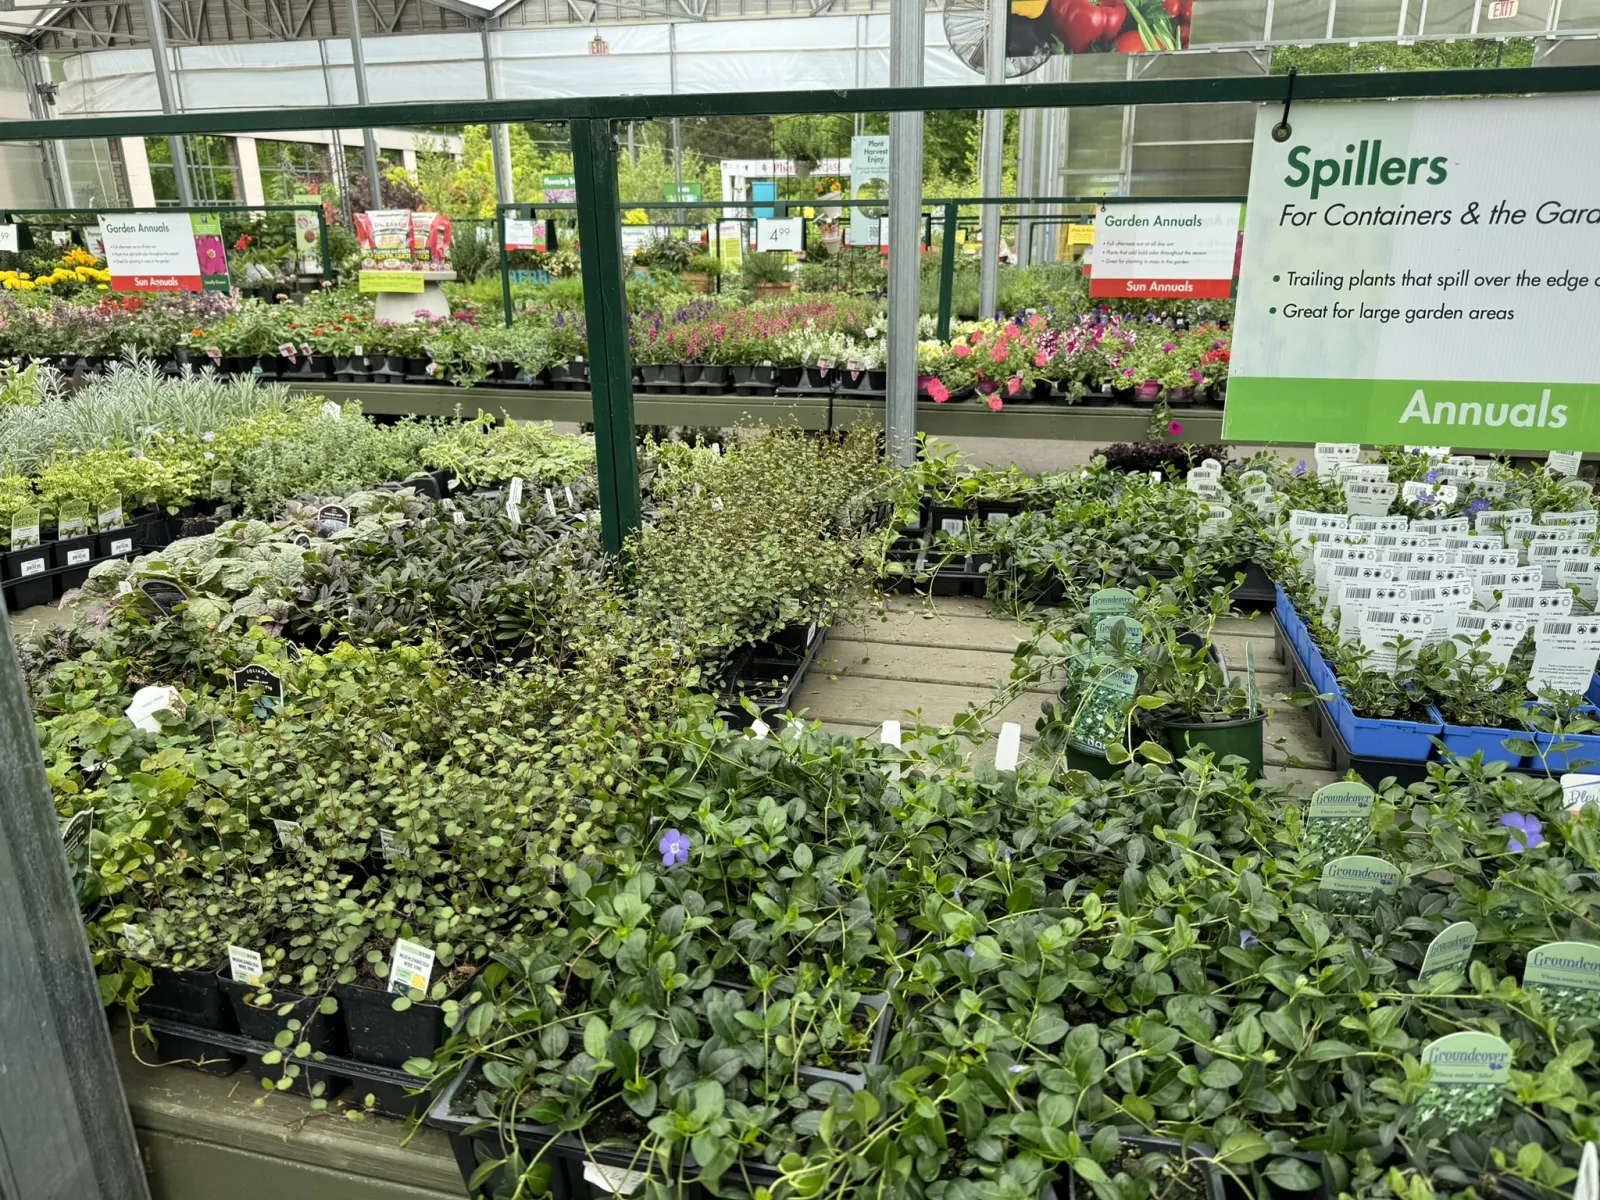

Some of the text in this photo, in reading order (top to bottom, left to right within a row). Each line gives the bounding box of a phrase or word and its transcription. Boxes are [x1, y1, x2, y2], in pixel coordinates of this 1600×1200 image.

[1493, 1, 1515, 17] EXIT
[867, 156, 884, 165] Enjoy
[1283, 139, 1449, 200] Spillers
[543, 177, 569, 187] Flowering
[1104, 213, 1203, 228] Garden Annuals
[1278, 204, 1317, 227] For
[1323, 203, 1452, 227] Containers
[1460, 201, 1481, 226] &
[1488, 200, 1527, 226] the
[106, 222, 170, 234] Garden Annuals
[134, 276, 179, 286] Sun Annuals
[1126, 280, 1194, 292] Sun Annuals
[1286, 271, 1344, 291] Trailing
[1348, 269, 1396, 291] plants
[1401, 269, 1433, 287] that
[1436, 269, 1470, 291] spill
[1474, 274, 1511, 288] over
[1515, 269, 1542, 287] the
[1546, 269, 1589, 291] edge
[1282, 302, 1515, 323] Great for large garden areas
[1398, 388, 1569, 428] Annuals
[1092, 595, 1132, 605] Groundcover
[1100, 623, 1140, 633] Groover
[246, 668, 268, 676] FOLIAGE
[1316, 791, 1371, 804] Groundcover
[1328, 864, 1397, 880] Groundcover
[1429, 1046, 1508, 1064] Groundcover
